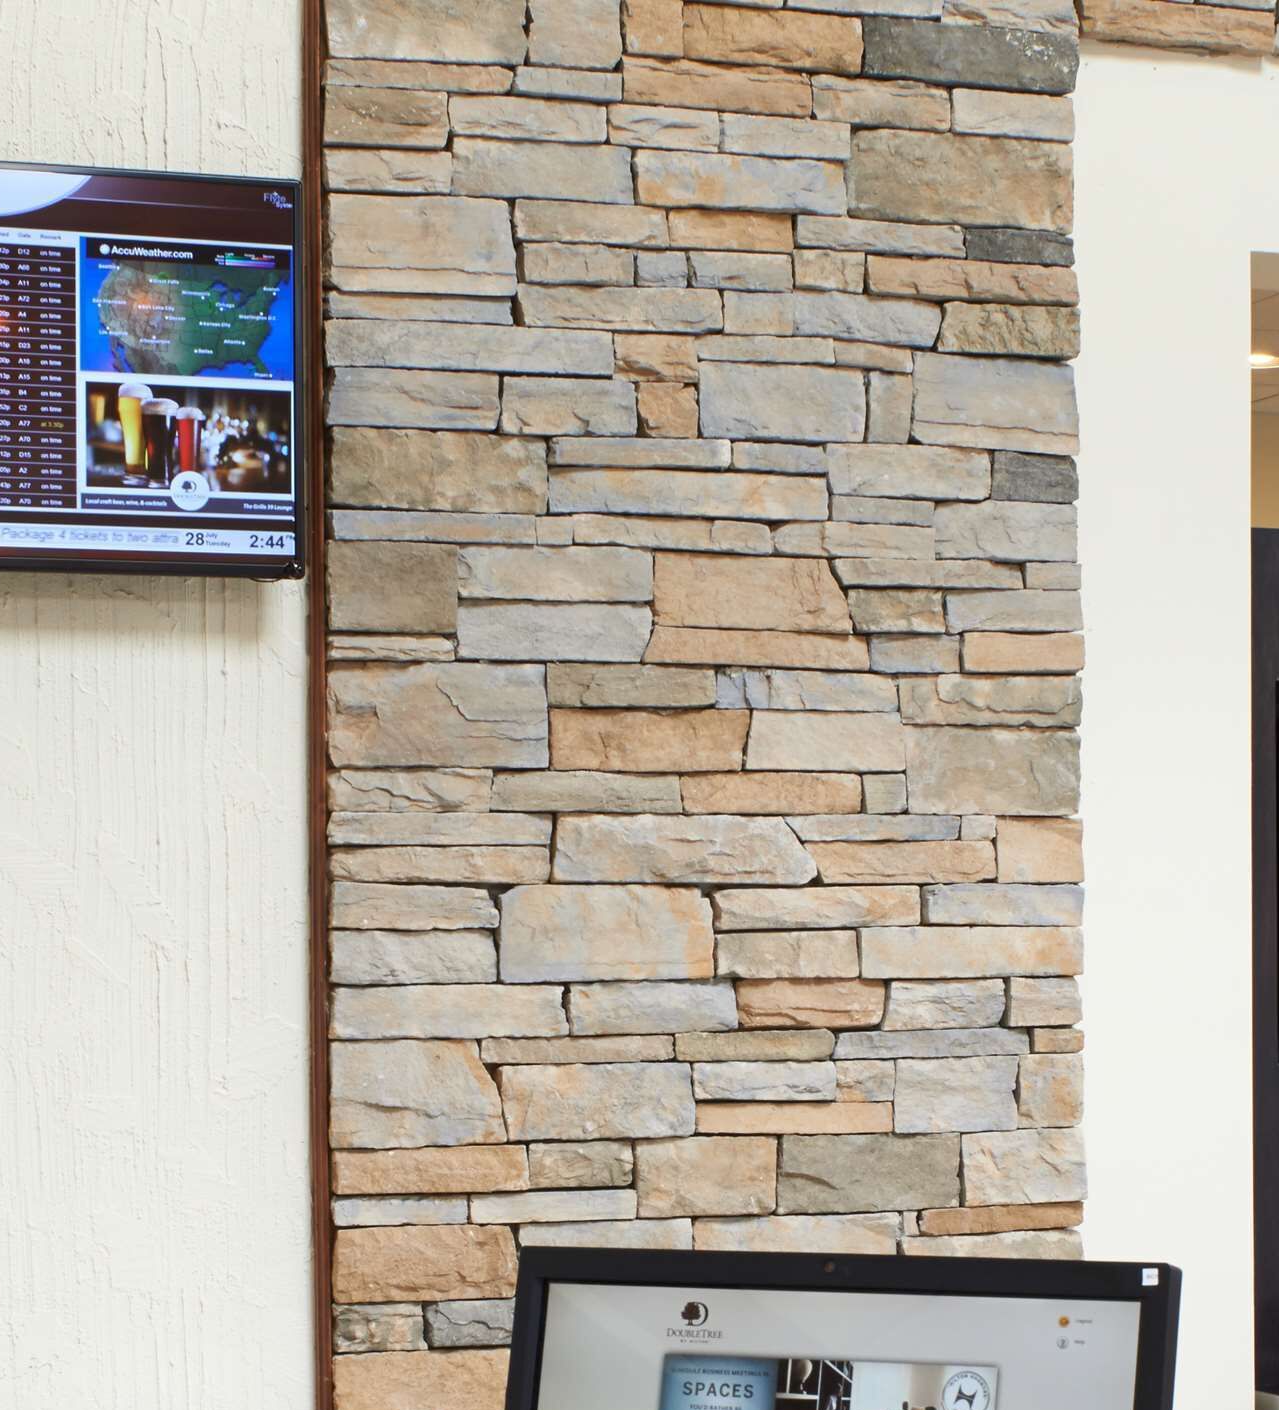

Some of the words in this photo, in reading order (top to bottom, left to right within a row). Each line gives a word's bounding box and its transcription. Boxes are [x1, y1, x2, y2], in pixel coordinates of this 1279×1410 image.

[111, 245, 194, 260] AccuWeather.com
[1, 528, 57, 544] Package
[58, 528, 68, 540] 4
[71, 530, 109, 543] tickets
[112, 531, 124, 543] to
[128, 532, 149, 544] two
[185, 532, 205, 547] 28
[206, 532, 218, 540] July
[249, 534, 285, 549] 2:44
[206, 540, 232, 548] Tuesday
[682, 1380, 755, 1400] SPACES
